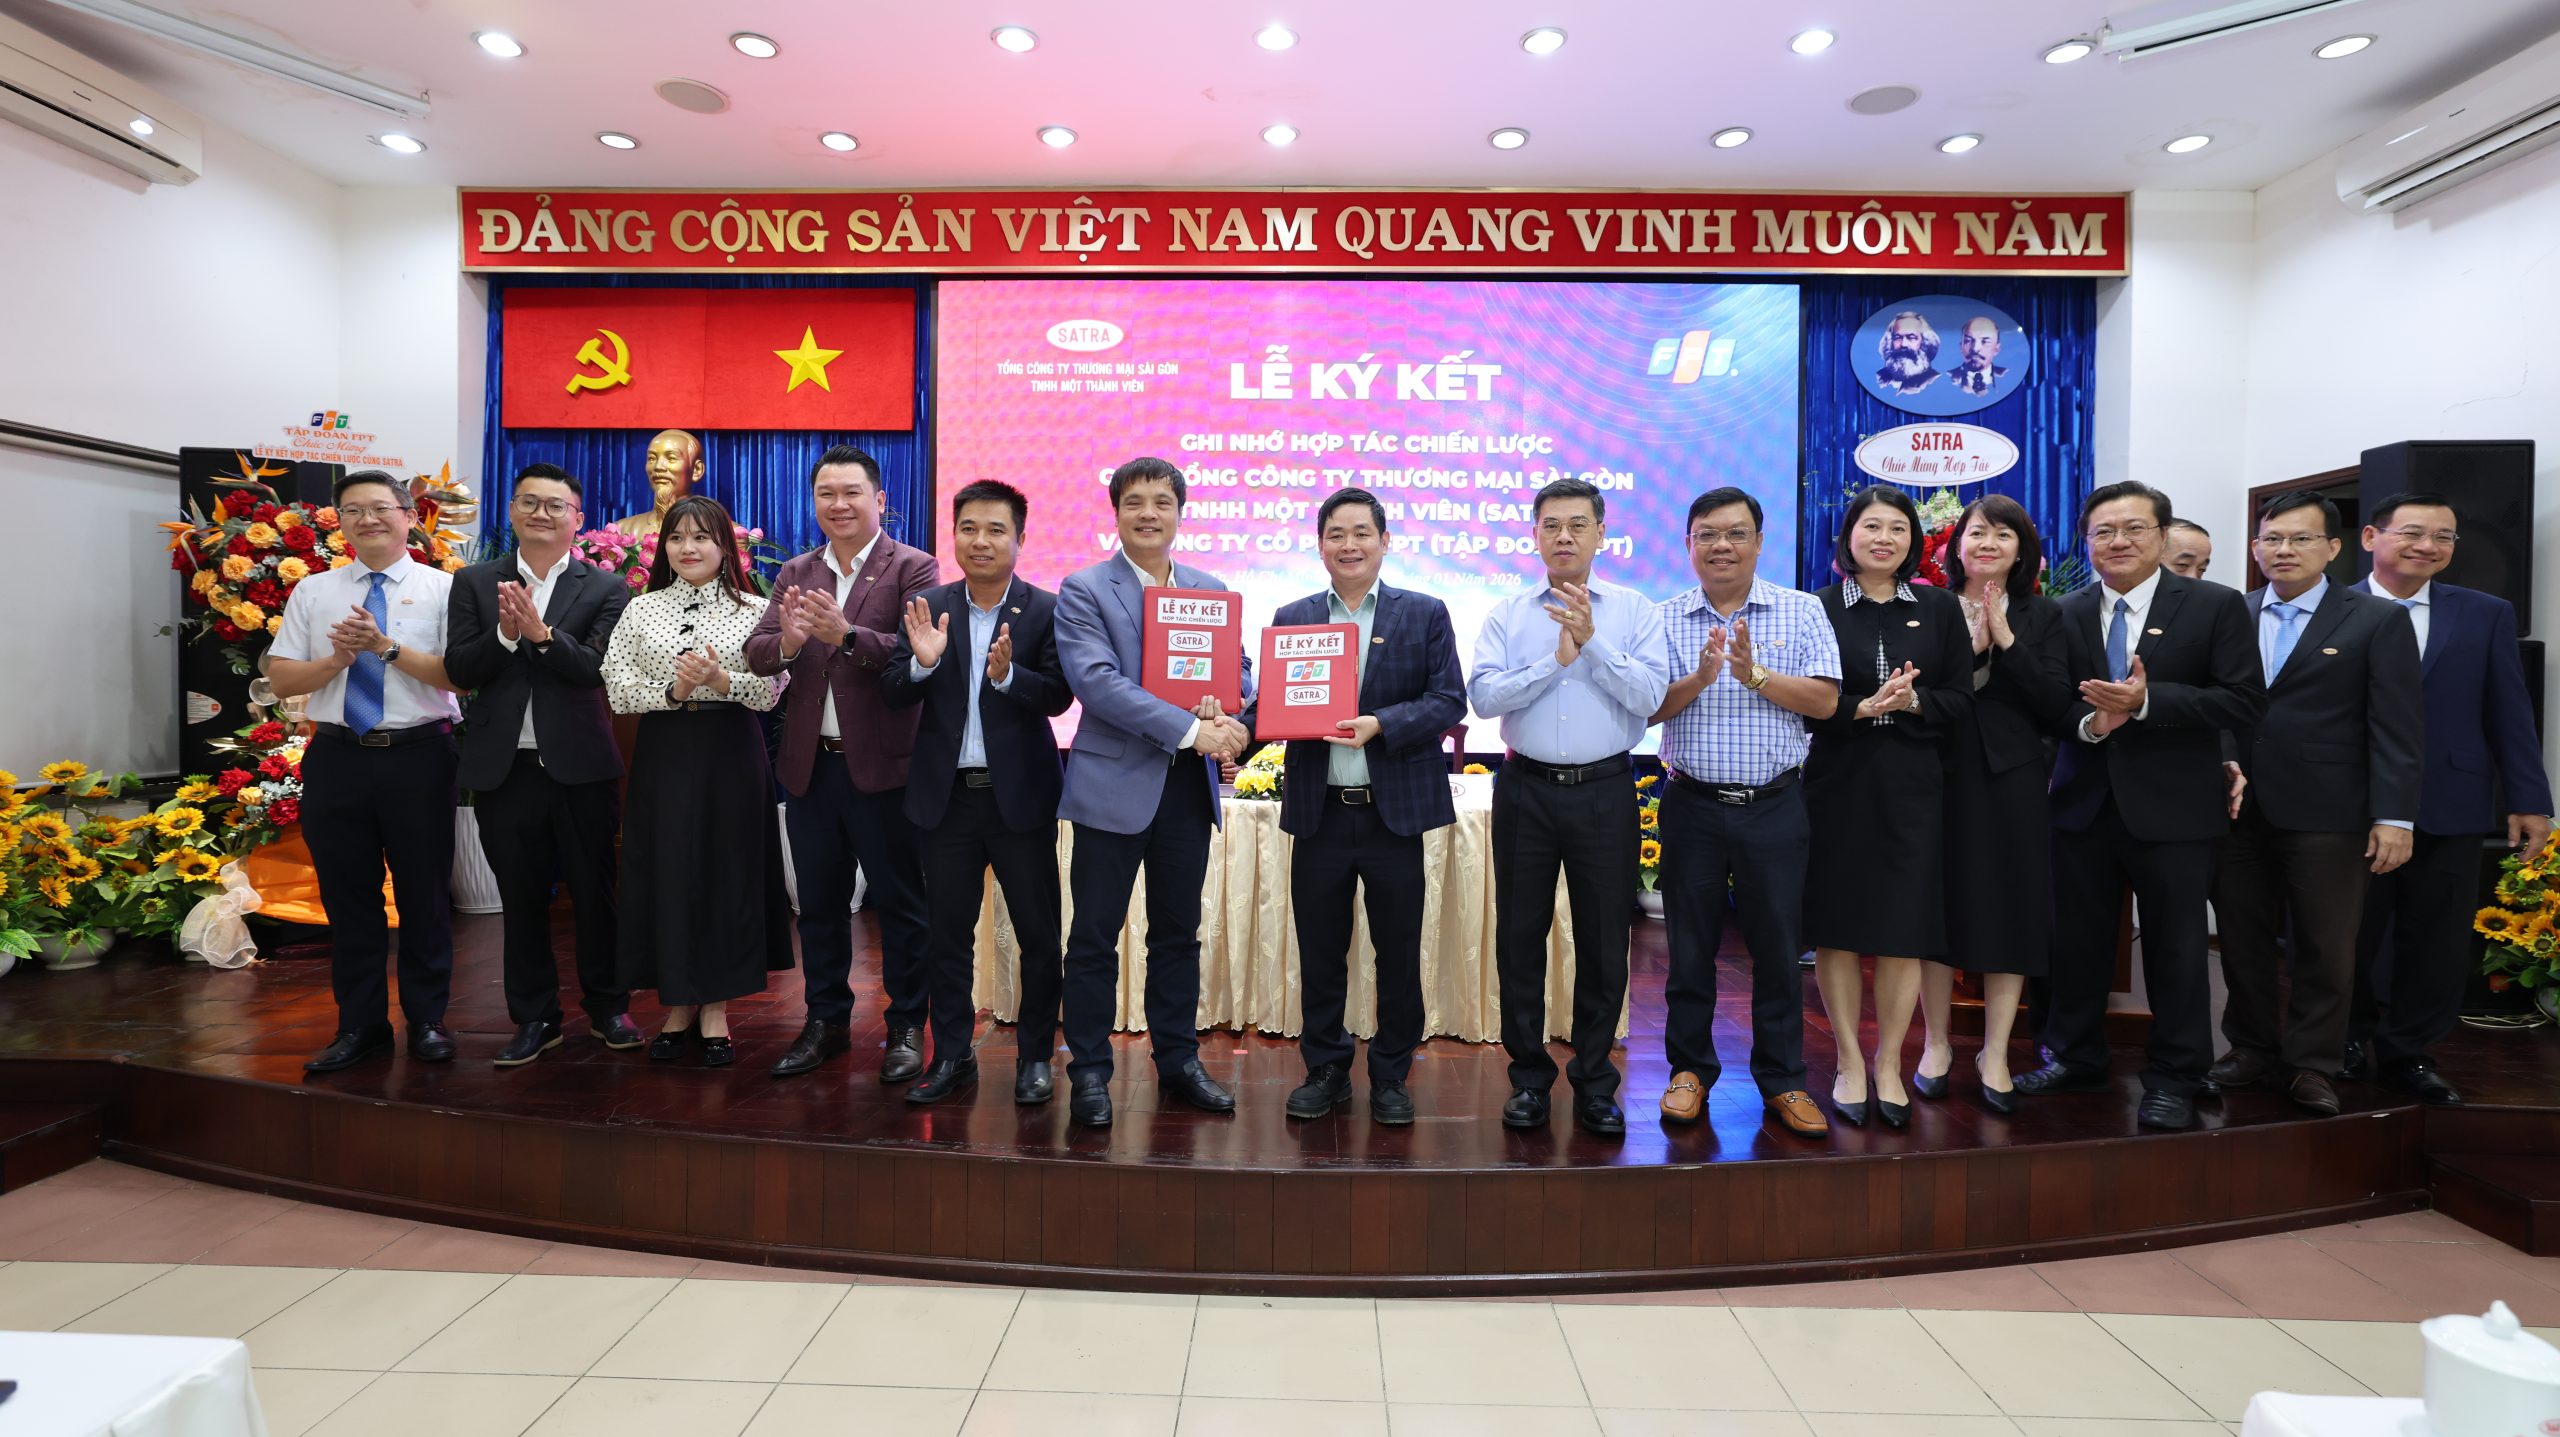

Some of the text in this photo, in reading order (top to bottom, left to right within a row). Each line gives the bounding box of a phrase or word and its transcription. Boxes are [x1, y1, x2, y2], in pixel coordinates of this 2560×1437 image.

[478, 194, 2108, 263] ĐẢNG CỘNG SẢN VIỆT NAM QUANG VINH MUÔN NĂM
[1057, 327, 1111, 343] SATRA
[997, 359, 1179, 377] TỔNG CÔNG TY THƯƠNG MẠI SÀI GÒN
[1230, 344, 1502, 401] LỄ KÝ KẾT
[1031, 378, 1145, 393] TNHH MỘT THÀNH VIÊN
[311, 410, 348, 431] FPT
[351, 432, 376, 442] FPT
[1180, 429, 1553, 459] GHI NHỚ HỢP TÁC CHIẾN LƯỢC
[1911, 431, 1964, 451] SATRA
[383, 456, 403, 467] SATRA
[1181, 461, 1238, 487] ỔNG
[1244, 464, 1317, 488] CÔNG
[1322, 469, 1355, 488] TY
[1361, 467, 1468, 489] THƯƠNG
[1475, 470, 1523, 494] MẠI
[1253, 497, 1310, 525] MỘT
[1411, 499, 1471, 521] VIÊN
[1170, 534, 1213, 552] NG
[1217, 534, 1251, 552] TY
[1388, 534, 1425, 553] PT
[1431, 531, 1490, 560] (TẬP
[1488, 573, 1522, 586] 2026
[1162, 599, 1223, 617] LỄ KÝ KẾT
[1176, 636, 1203, 646] SATRA
[1280, 634, 1341, 649] LỄ KÝ KẾT
[1172, 658, 1206, 679] FPT
[1291, 661, 1325, 681] FPT
[1293, 690, 1321, 700] SATRA
